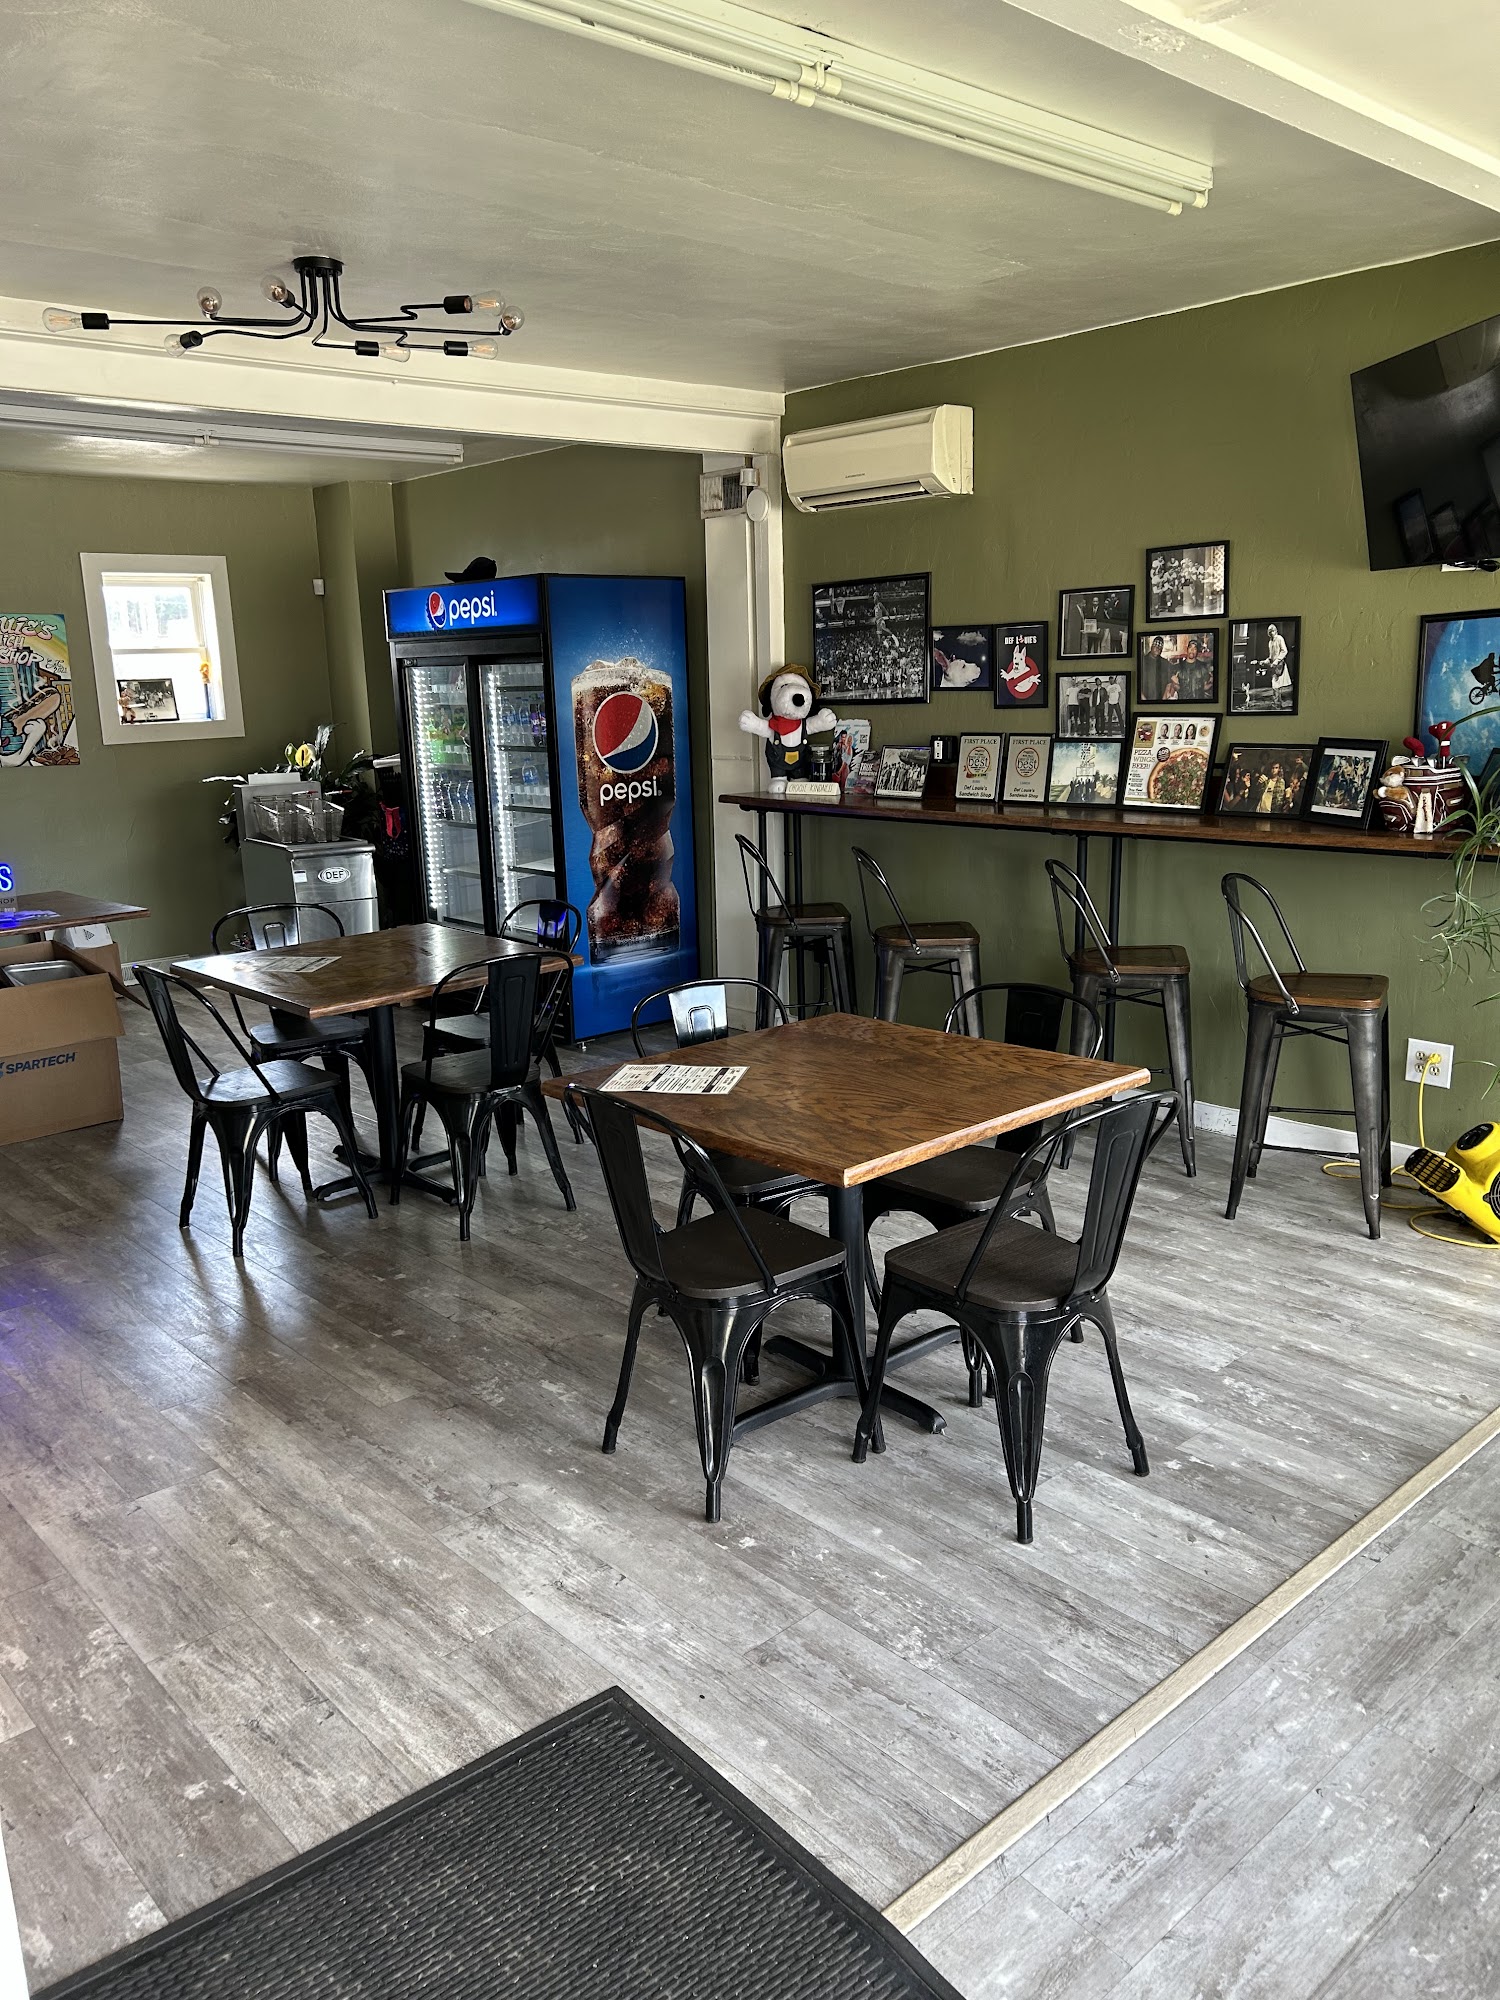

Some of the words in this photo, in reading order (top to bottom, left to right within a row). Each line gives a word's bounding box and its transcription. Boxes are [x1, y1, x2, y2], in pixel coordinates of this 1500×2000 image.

[449, 590, 495, 627] pepsi
[969, 758, 988, 767] best
[1018, 760, 1037, 769] best
[600, 775, 657, 807] pepsi
[325, 871, 344, 880] DEF
[6, 1052, 76, 1074] SPARTECH
